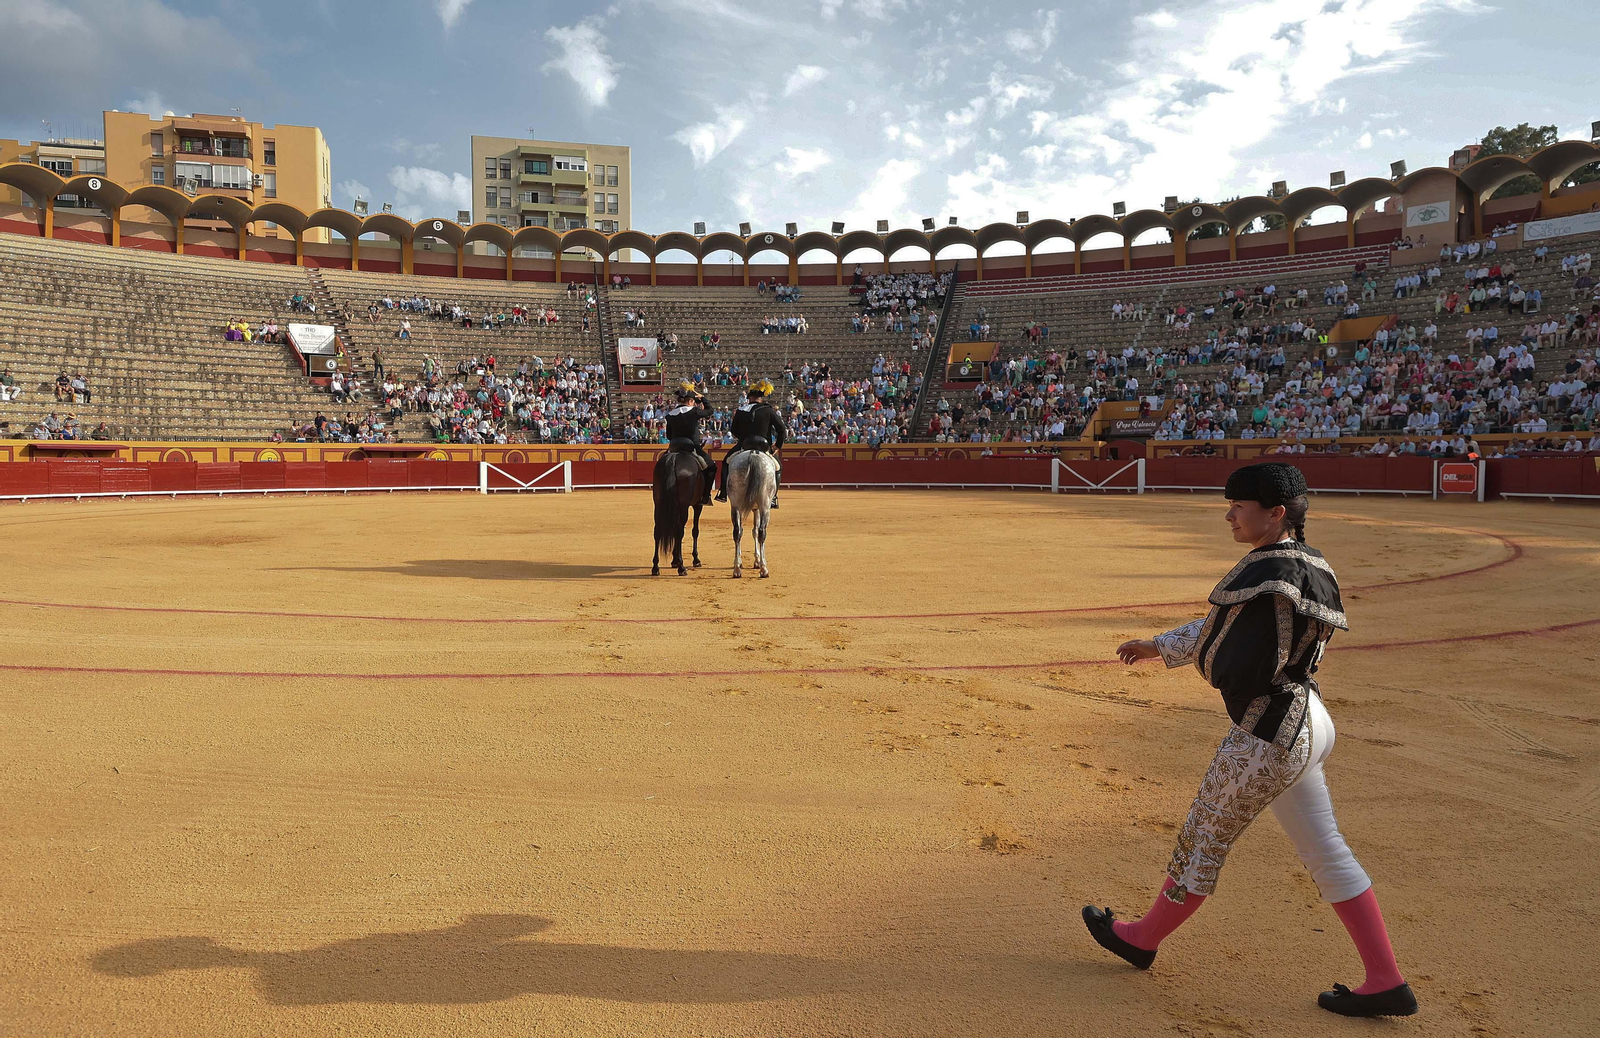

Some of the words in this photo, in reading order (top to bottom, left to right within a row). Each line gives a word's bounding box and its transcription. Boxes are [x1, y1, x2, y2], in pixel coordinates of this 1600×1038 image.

[1541, 222, 1553, 230] de
[1116, 420, 1131, 430] Pepe
[1131, 420, 1157, 429] Valencia
